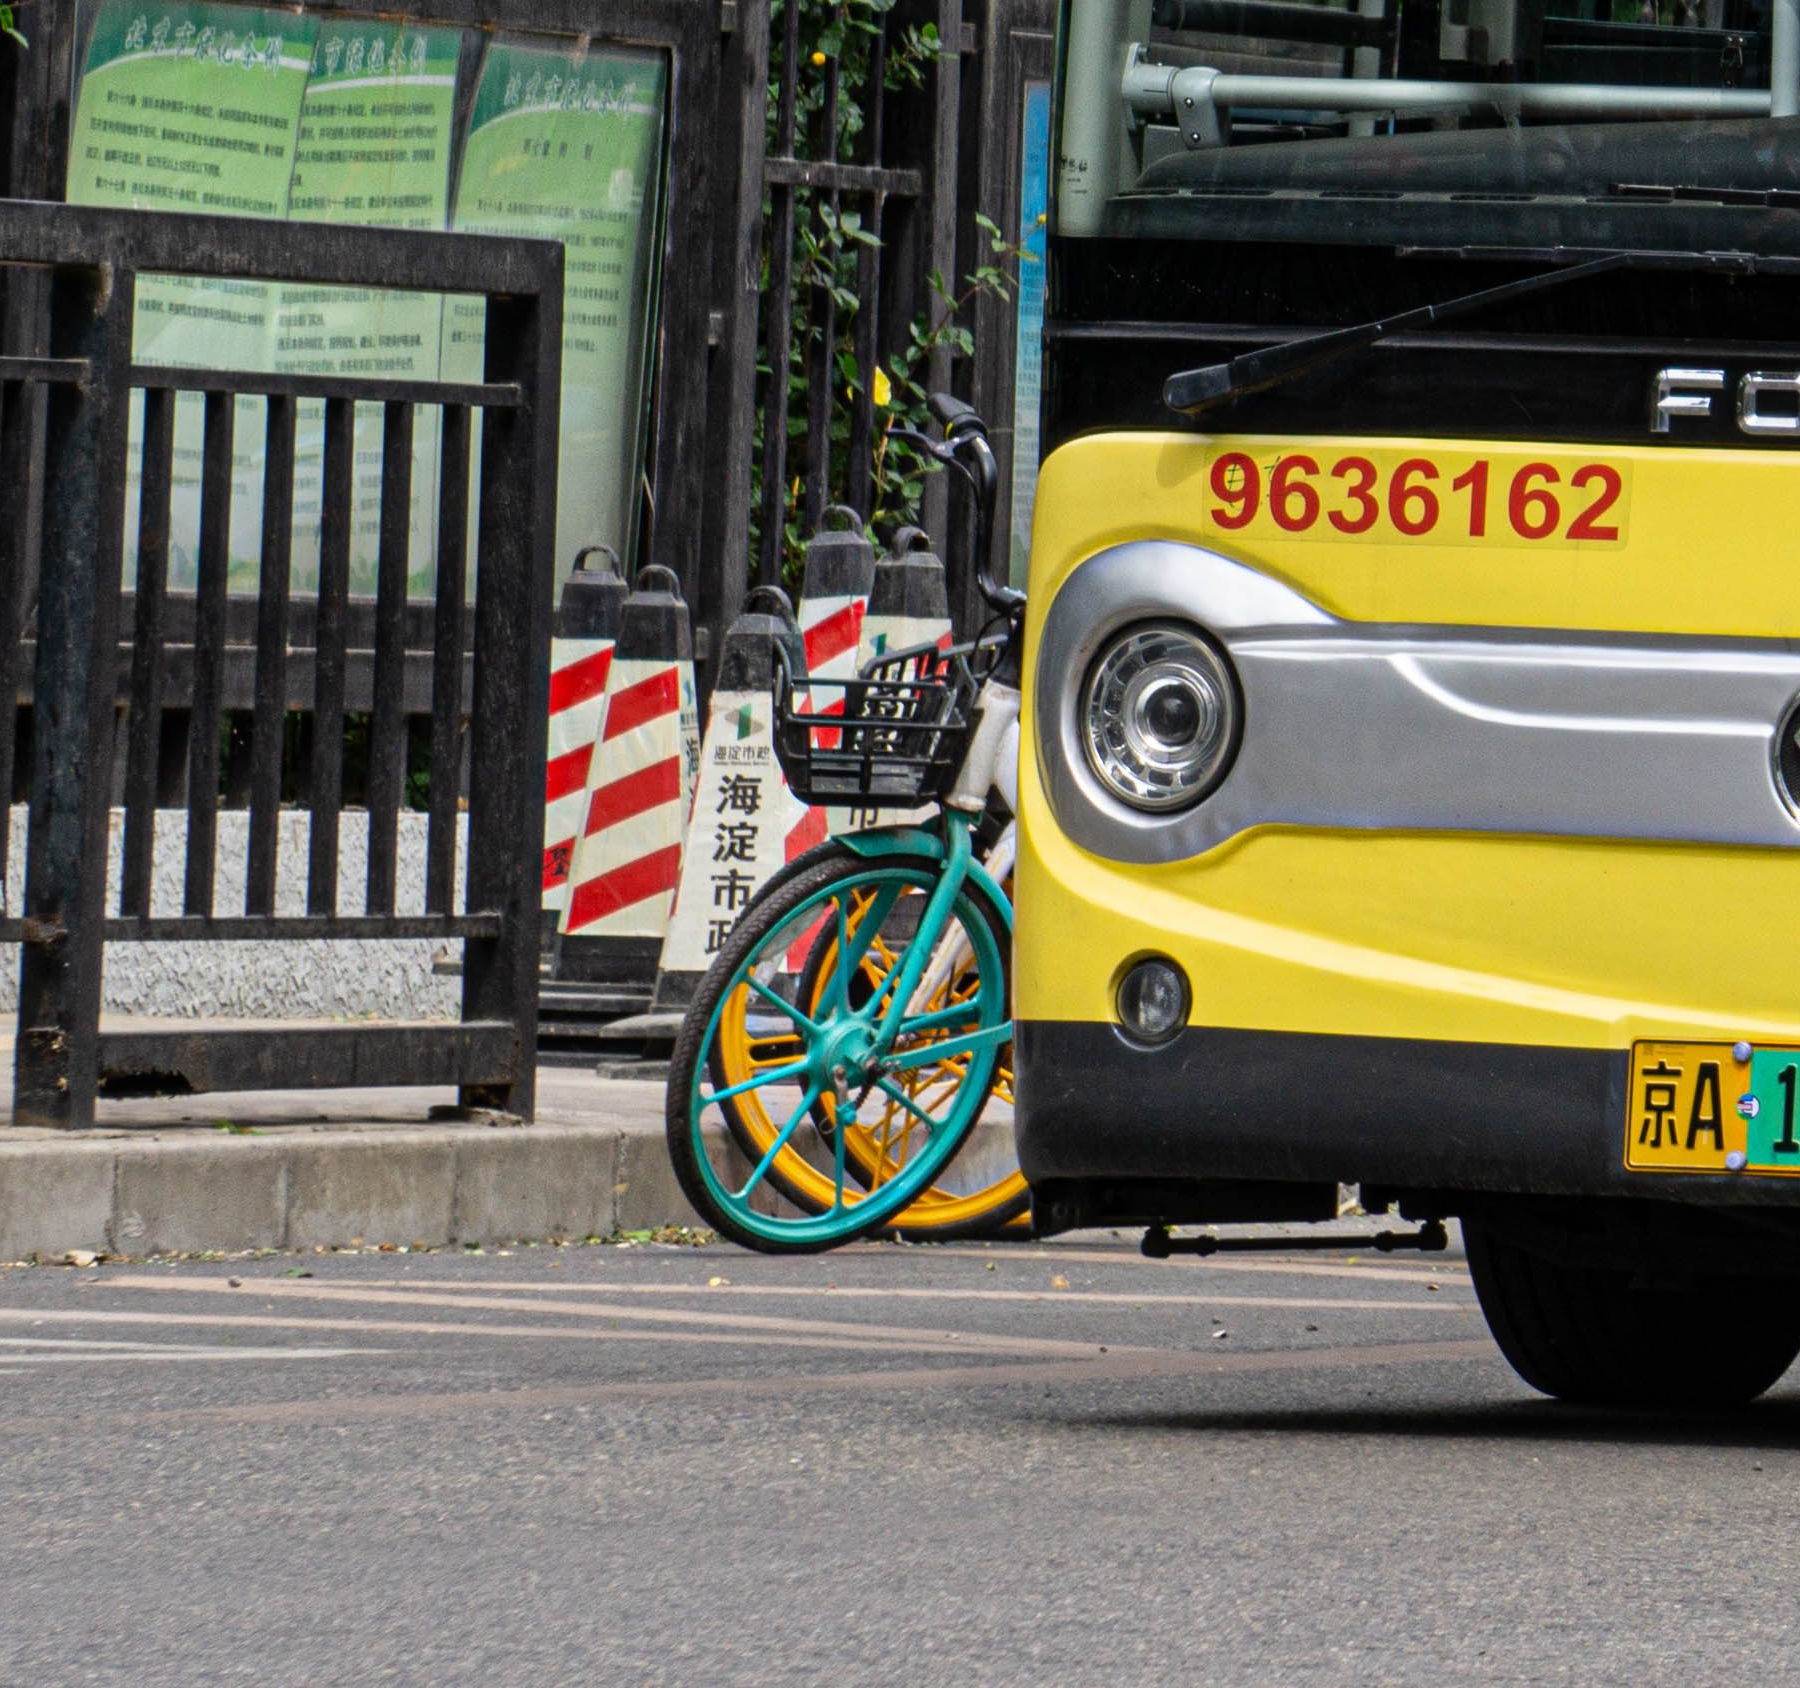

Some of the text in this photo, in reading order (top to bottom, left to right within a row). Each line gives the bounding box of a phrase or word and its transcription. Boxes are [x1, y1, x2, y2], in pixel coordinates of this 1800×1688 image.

[1210, 451, 1623, 542] 9636162
[713, 743, 771, 761] 海淀市政
[1639, 1059, 1725, 1151] 京A
